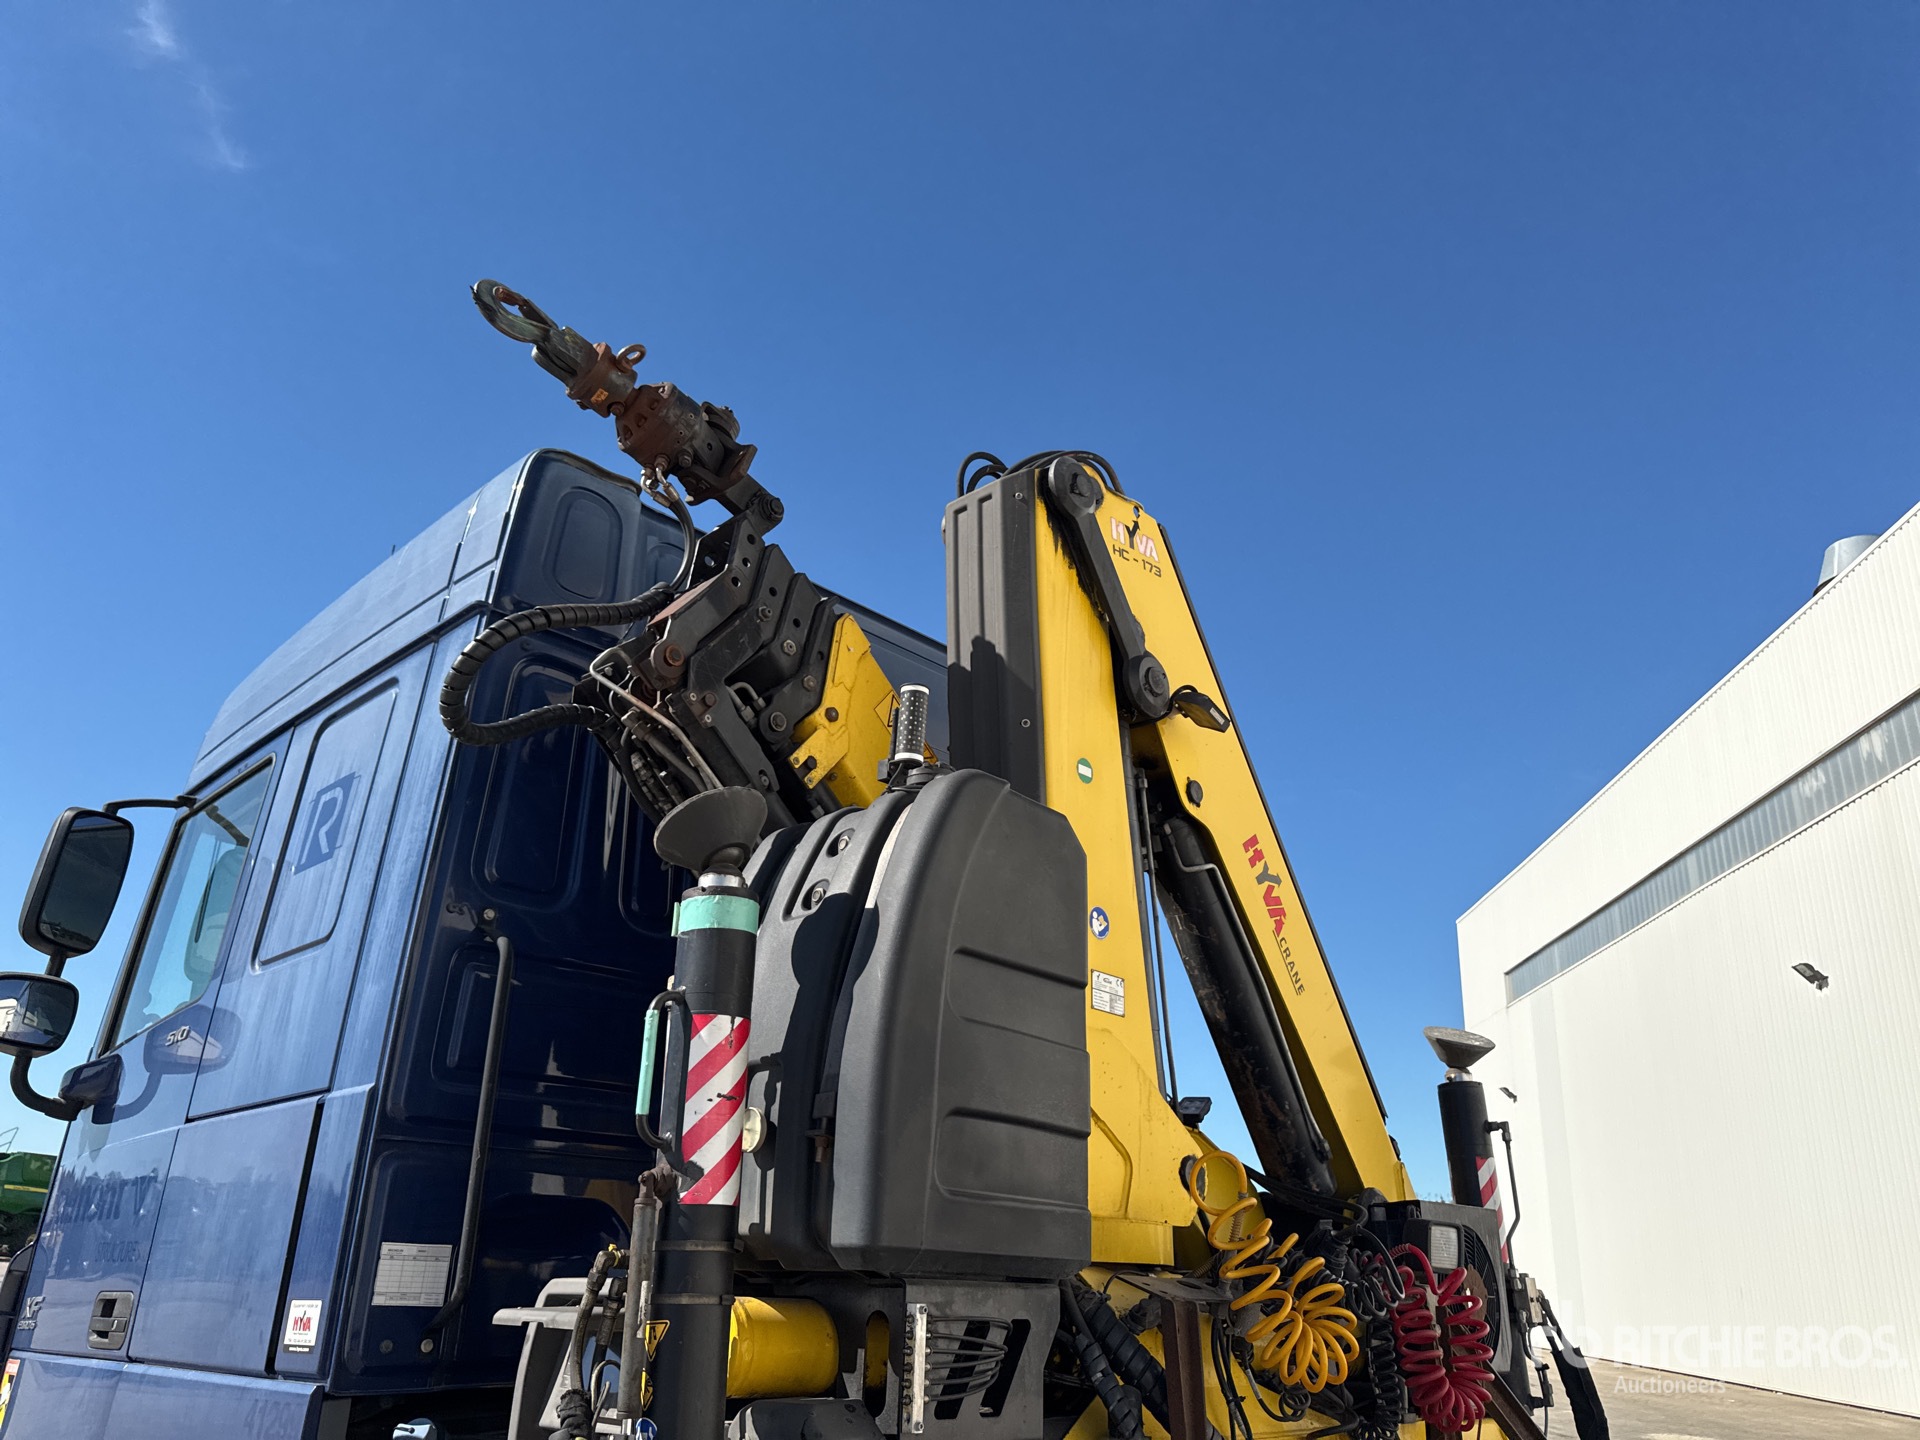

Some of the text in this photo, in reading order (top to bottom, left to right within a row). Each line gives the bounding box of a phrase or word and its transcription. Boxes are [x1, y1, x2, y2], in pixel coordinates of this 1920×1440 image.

[1110, 516, 1160, 563] HYVA
[1112, 544, 1130, 562] HC
[1141, 559, 1162, 578] 173
[1242, 834, 1287, 938] HYVA
[1279, 936, 1306, 996] CRANE
[165, 1025, 191, 1047] 510
[21, 1296, 45, 1319] XF
[292, 1310, 311, 1332] HYVA
